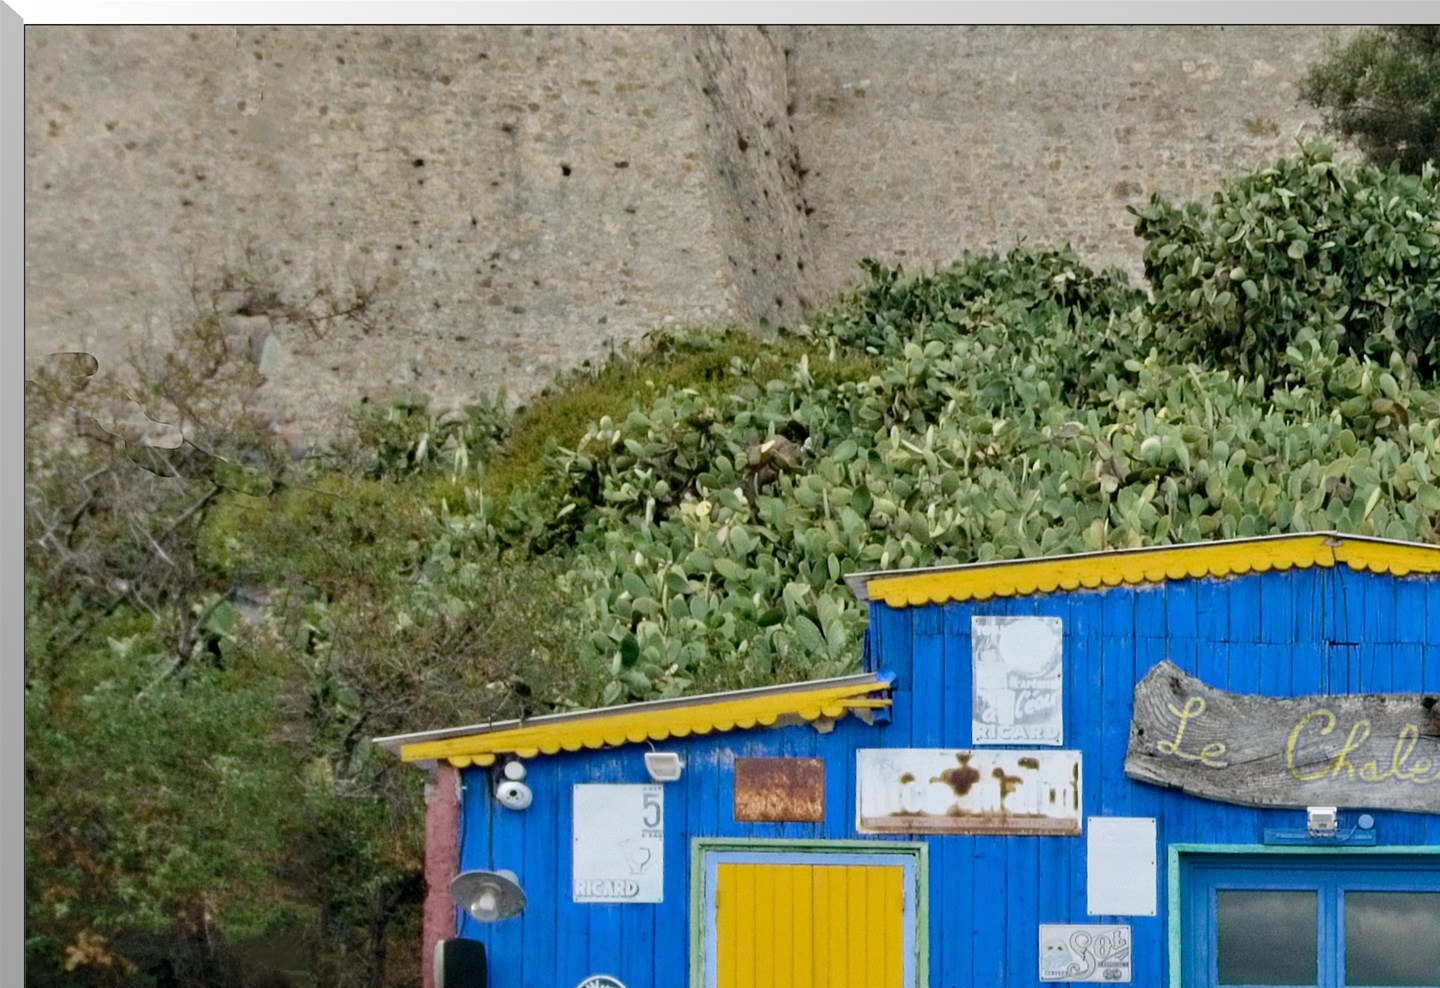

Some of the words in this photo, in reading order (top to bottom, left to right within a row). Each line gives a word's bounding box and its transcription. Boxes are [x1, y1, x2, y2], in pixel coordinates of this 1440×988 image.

[977, 725, 1061, 740] RICARD
[1156, 696, 1229, 769] Le
[642, 792, 662, 828] 5
[574, 879, 640, 898] RICARD
